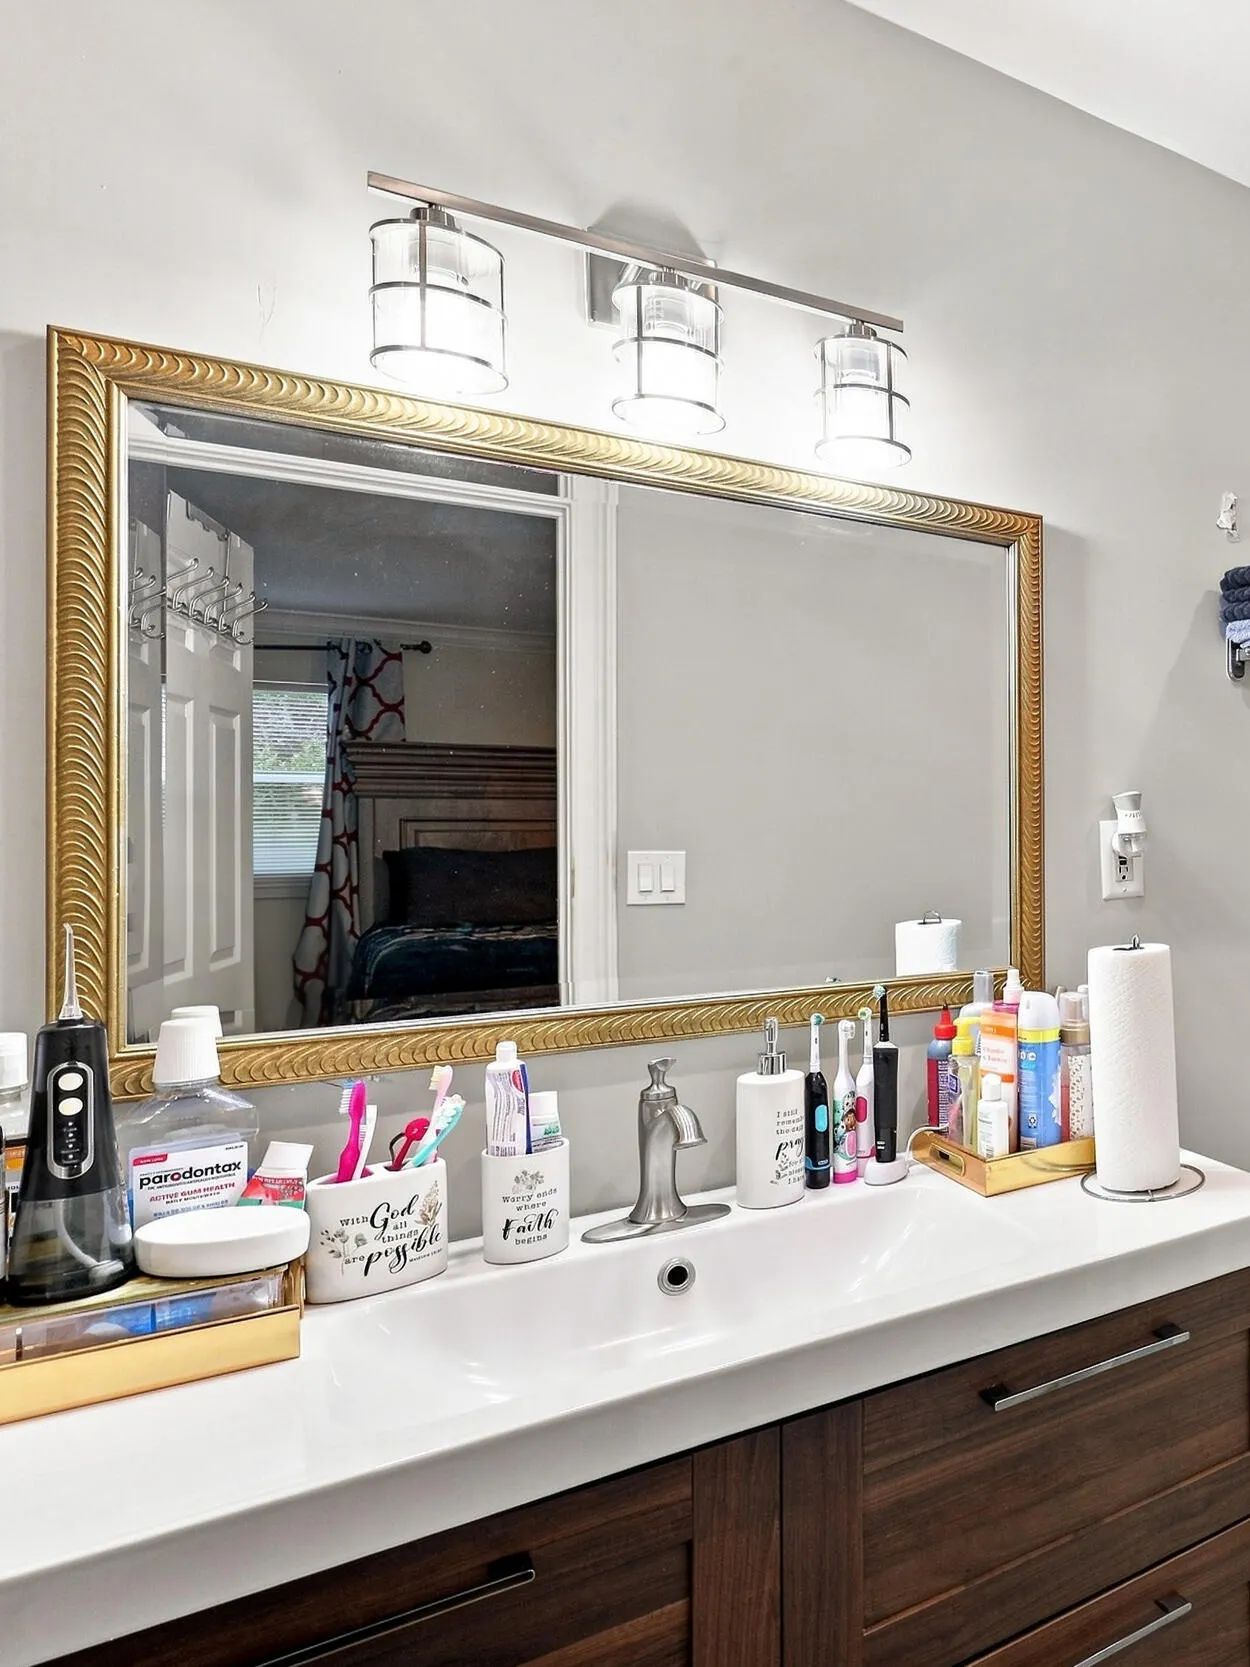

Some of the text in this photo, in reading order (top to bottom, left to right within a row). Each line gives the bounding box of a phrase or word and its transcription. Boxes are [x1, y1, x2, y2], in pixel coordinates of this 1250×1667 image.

[139, 1161, 241, 1190] parodontax
[149, 1182, 235, 1202] ACTIVE GUM HEALTH
[502, 1188, 557, 1204] Worry ends
[516, 1201, 547, 1211] where
[340, 1194, 420, 1241] With God
[392, 1221, 407, 1230] all
[502, 1208, 559, 1240] Faith
[381, 1229, 419, 1243] things
[515, 1234, 548, 1245] begins
[344, 1223, 442, 1277] are possible
